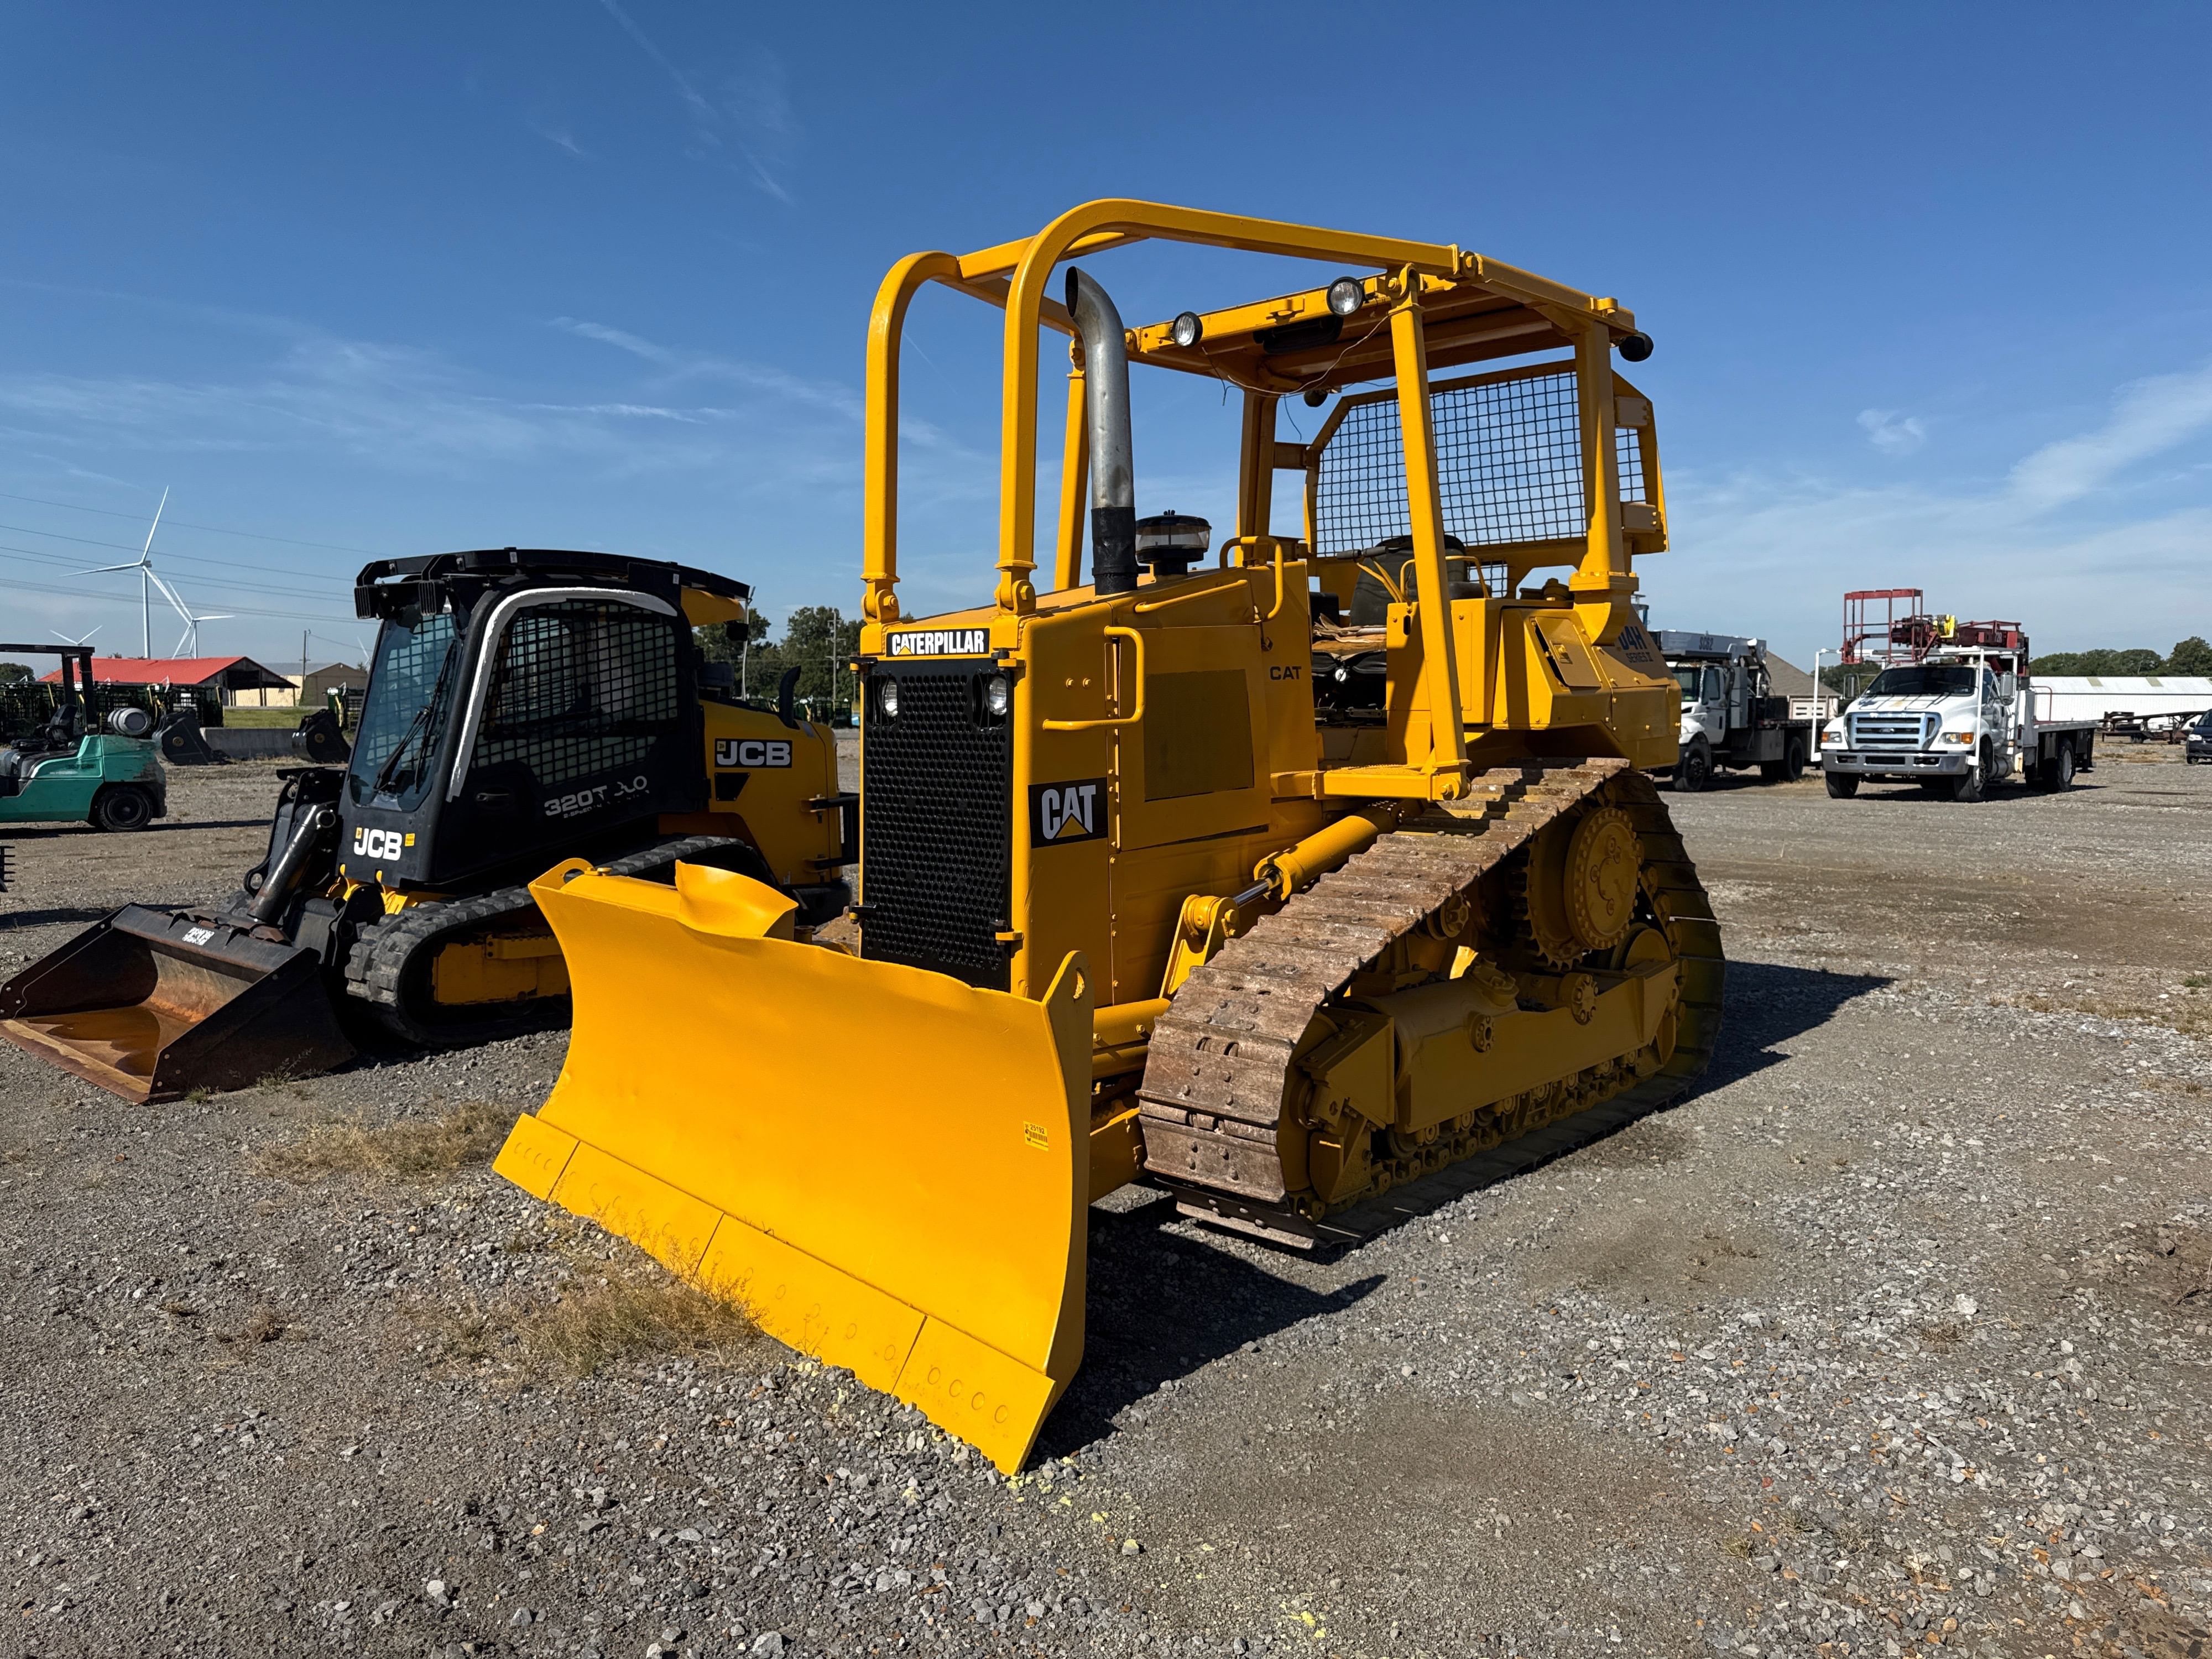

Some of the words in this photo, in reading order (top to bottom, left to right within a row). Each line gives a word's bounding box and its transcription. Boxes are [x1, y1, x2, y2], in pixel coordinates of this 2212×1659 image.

[892, 631, 984, 656] CATERPILLAR
[1626, 653, 1649, 663] SERIES
[1270, 666, 1302, 680] CAT
[717, 741, 790, 765] JCB
[544, 785, 607, 816] 320T
[1041, 785, 1096, 839] CAT
[354, 828, 402, 861] JCB
[1030, 1124, 1045, 1134] 25192
